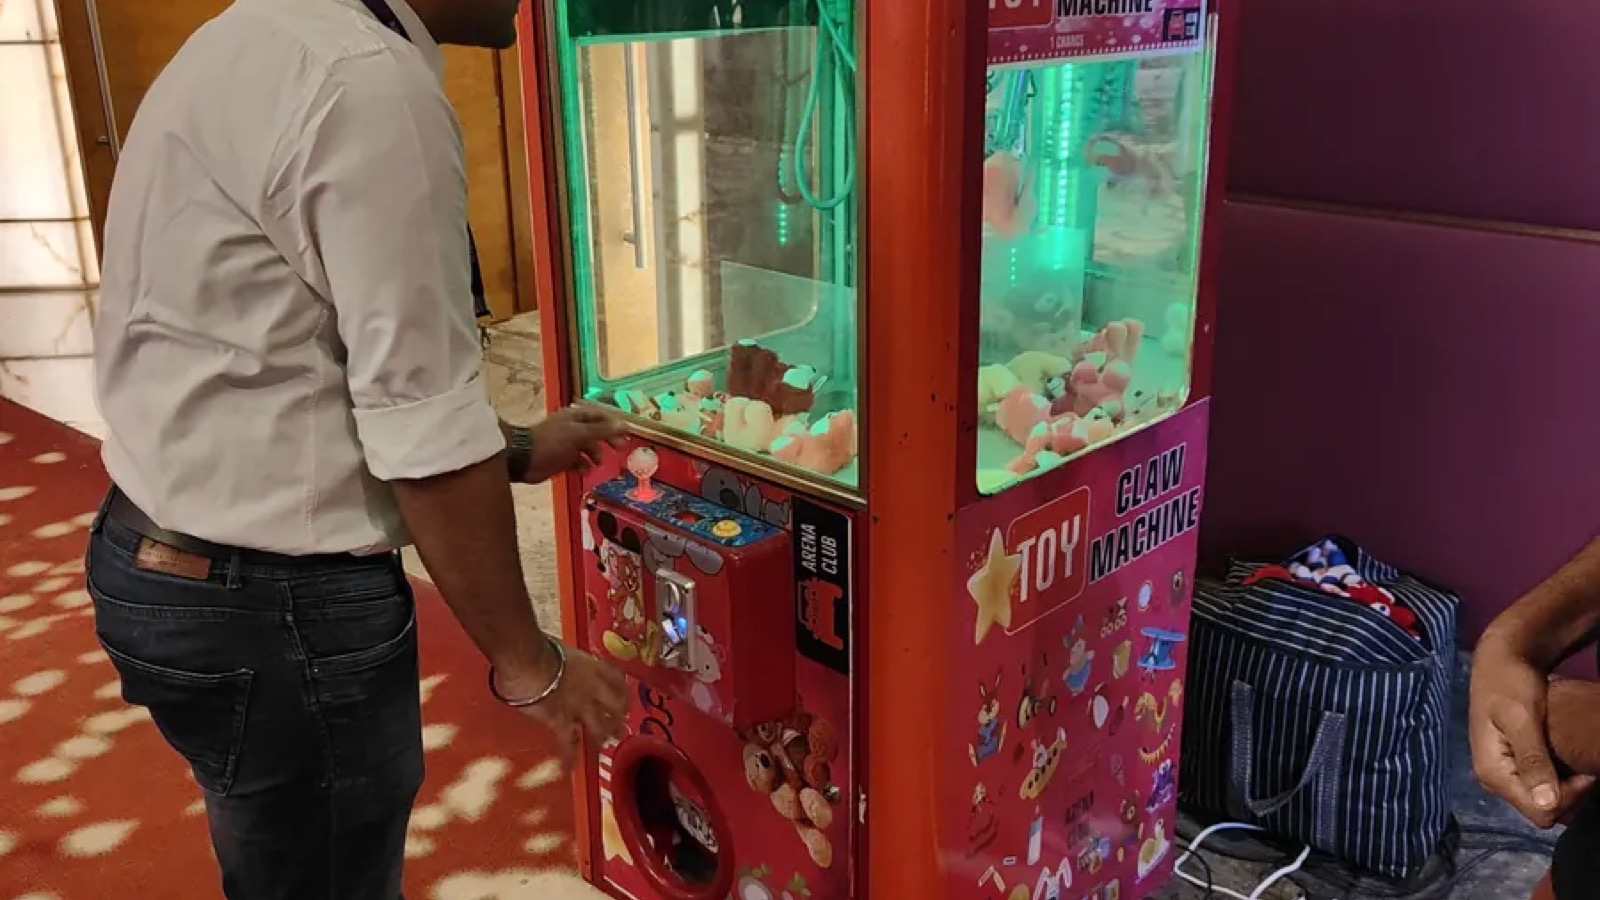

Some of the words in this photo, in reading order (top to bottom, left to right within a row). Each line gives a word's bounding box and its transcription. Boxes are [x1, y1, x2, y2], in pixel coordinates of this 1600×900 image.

[1116, 443, 1186, 516] CLAW
[801, 523, 817, 573] ARENA
[820, 535, 838, 575] CLUB
[1016, 514, 1082, 603] TOY
[1089, 487, 1200, 584] MACHINE
